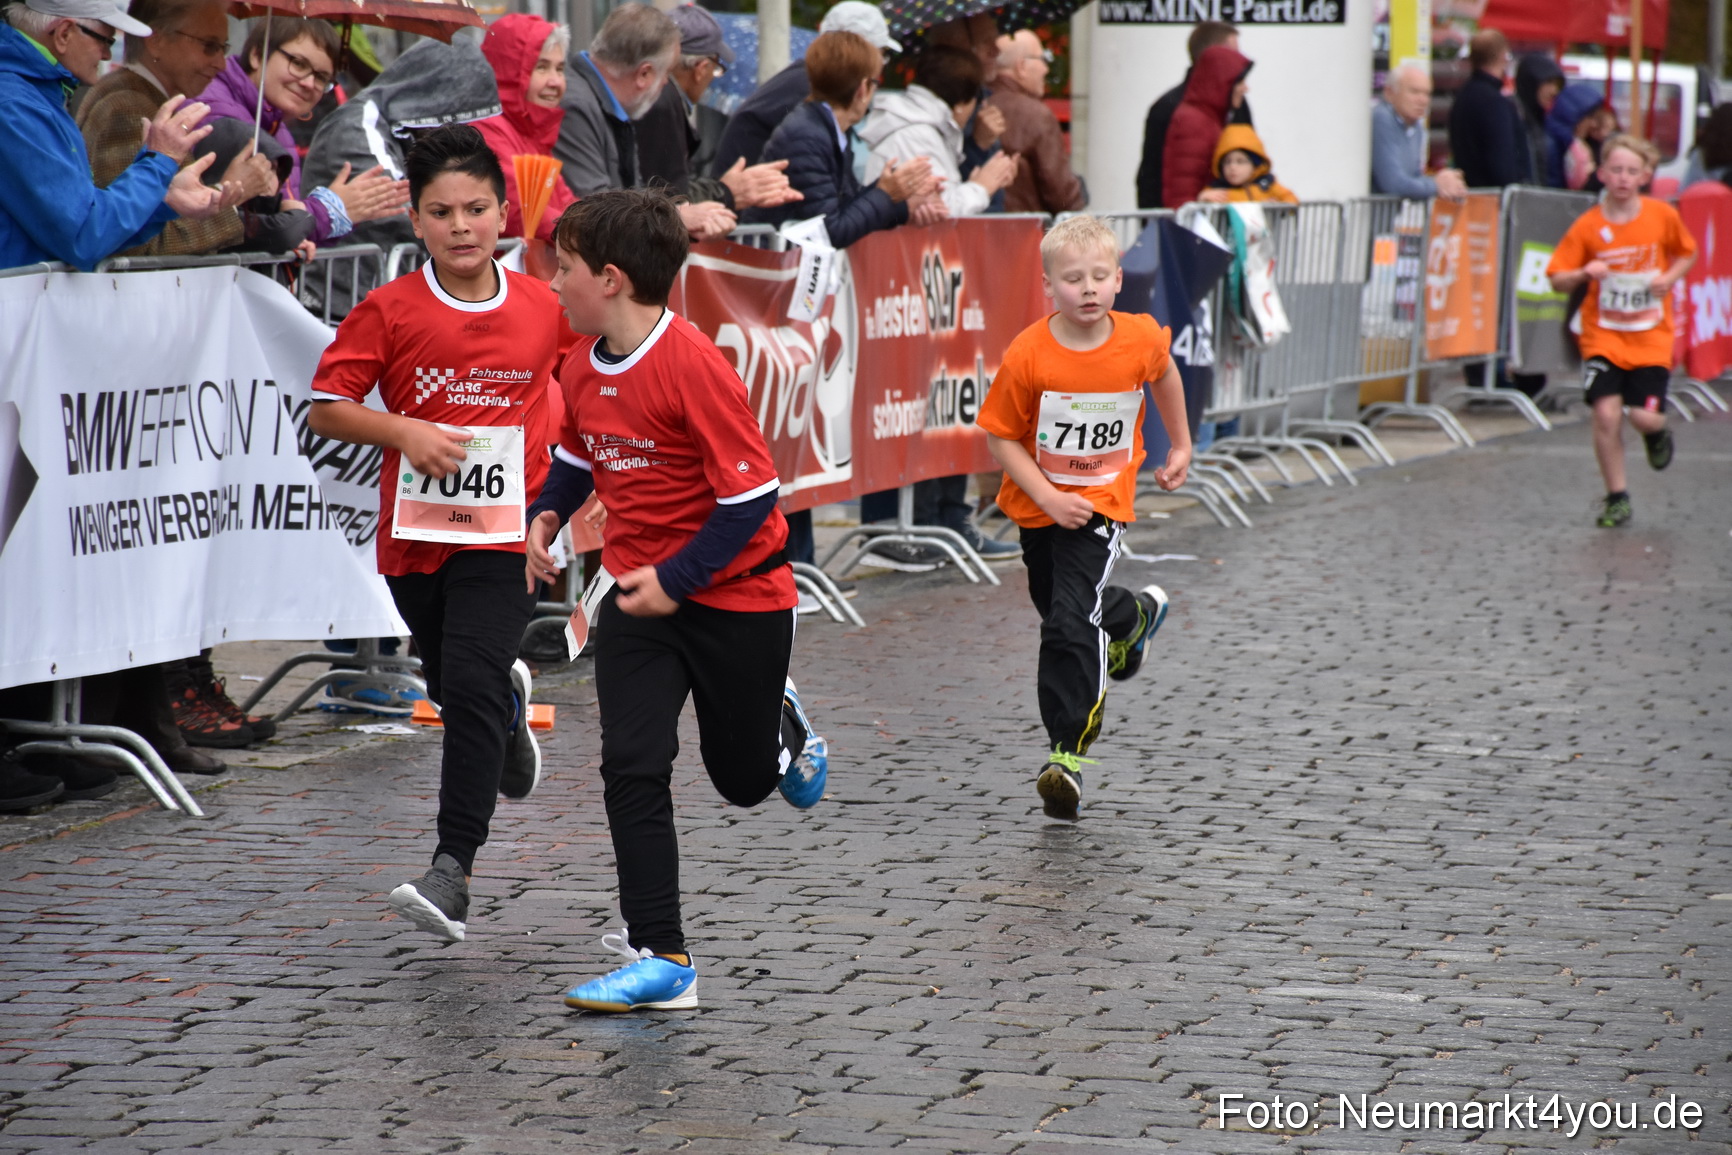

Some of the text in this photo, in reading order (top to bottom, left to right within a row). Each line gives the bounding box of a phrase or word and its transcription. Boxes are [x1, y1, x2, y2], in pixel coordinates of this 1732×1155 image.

[462, 323, 490, 332] JAKO
[469, 367, 533, 380] Fahrschule
[445, 381, 482, 393] KARG
[599, 386, 618, 396] JAKO
[446, 393, 511, 407] SCHUCHNA
[1081, 401, 1117, 411] BOCK
[60, 389, 139, 476] BMW
[1054, 419, 1124, 451] 7189
[601, 434, 655, 449] Fahrschule
[1069, 459, 1103, 470] Florian
[402, 487, 412, 495] B6
[448, 510, 472, 524] Jan
[69, 498, 144, 557] WENIGER
